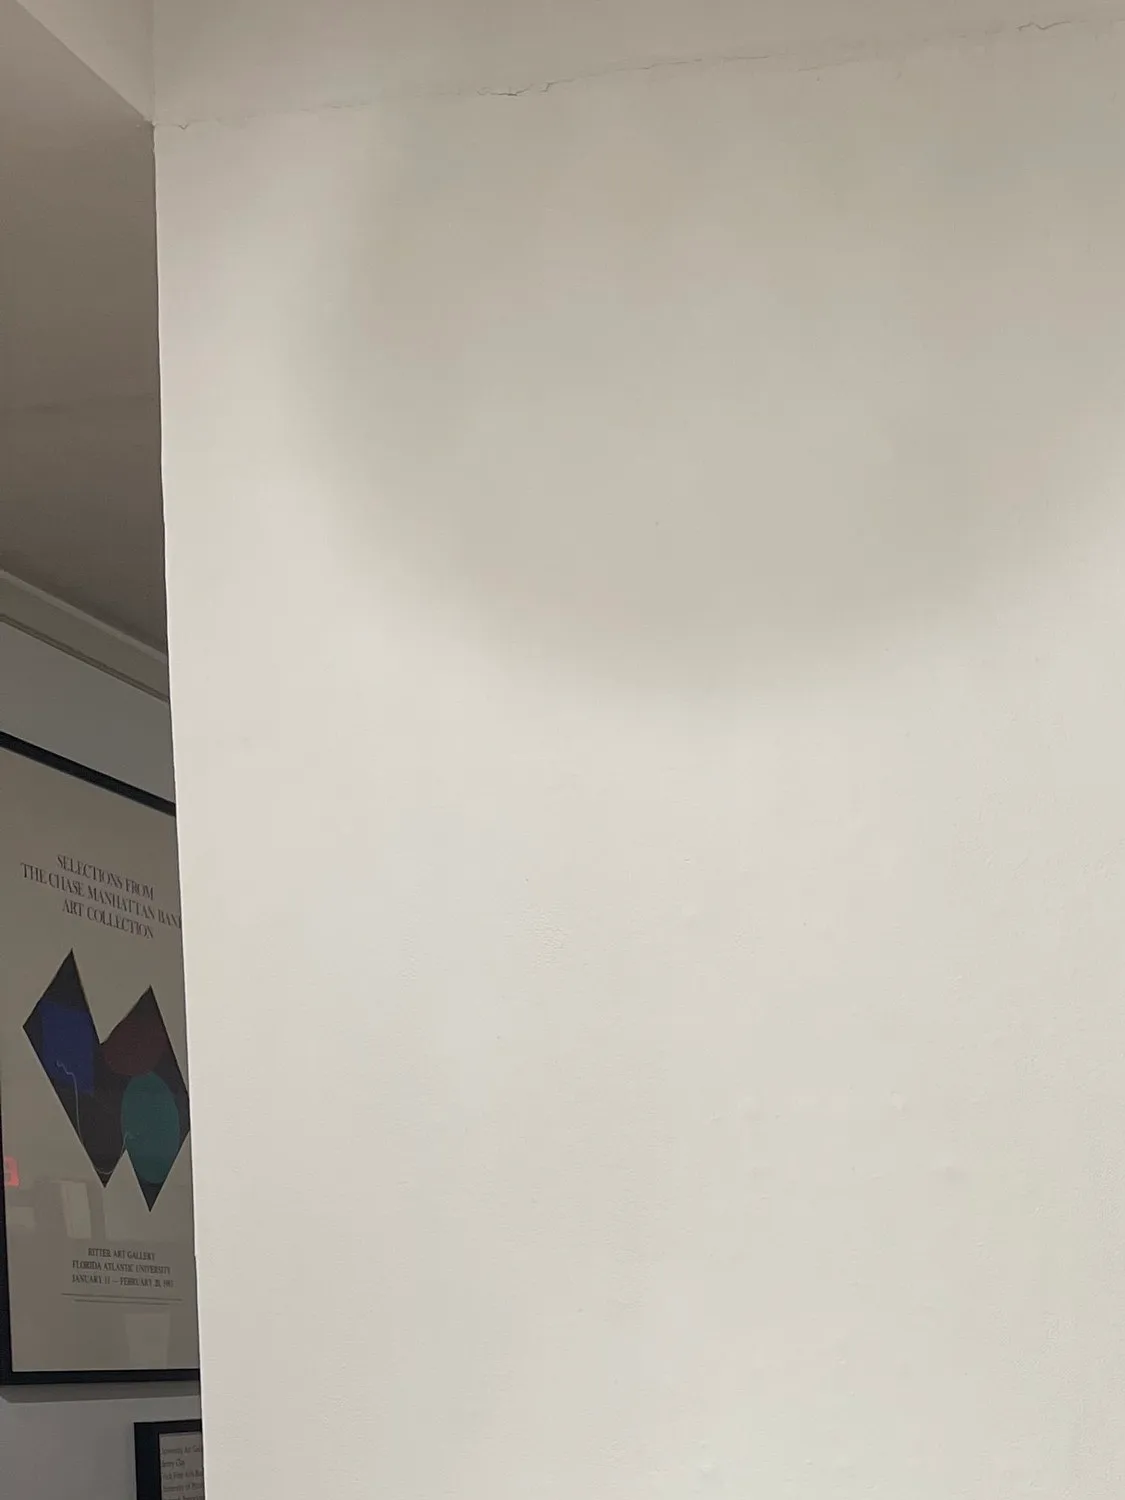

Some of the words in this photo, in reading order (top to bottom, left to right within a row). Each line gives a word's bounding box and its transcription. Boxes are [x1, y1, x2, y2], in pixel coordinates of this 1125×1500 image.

[57, 854, 123, 890] SELECTIONS
[125, 878, 154, 900] FROM
[20, 862, 47, 885] THE
[48, 872, 85, 897] CHASE
[87, 885, 155, 920] MANHATTAN
[158, 908, 182, 929] BAN
[62, 900, 85, 917] ART
[86, 906, 154, 938] COLLECTION
[72, 1260, 102, 1270] FLORIDA
[103, 1262, 133, 1272] ATLANTIC
[135, 1264, 171, 1275] UNIVERSITY
[113, 1250, 125, 1259] ART
[127, 1250, 156, 1261] GALLERY
[72, 1274, 102, 1285] JANUARY
[120, 1276, 152, 1287] FEBRUARY
